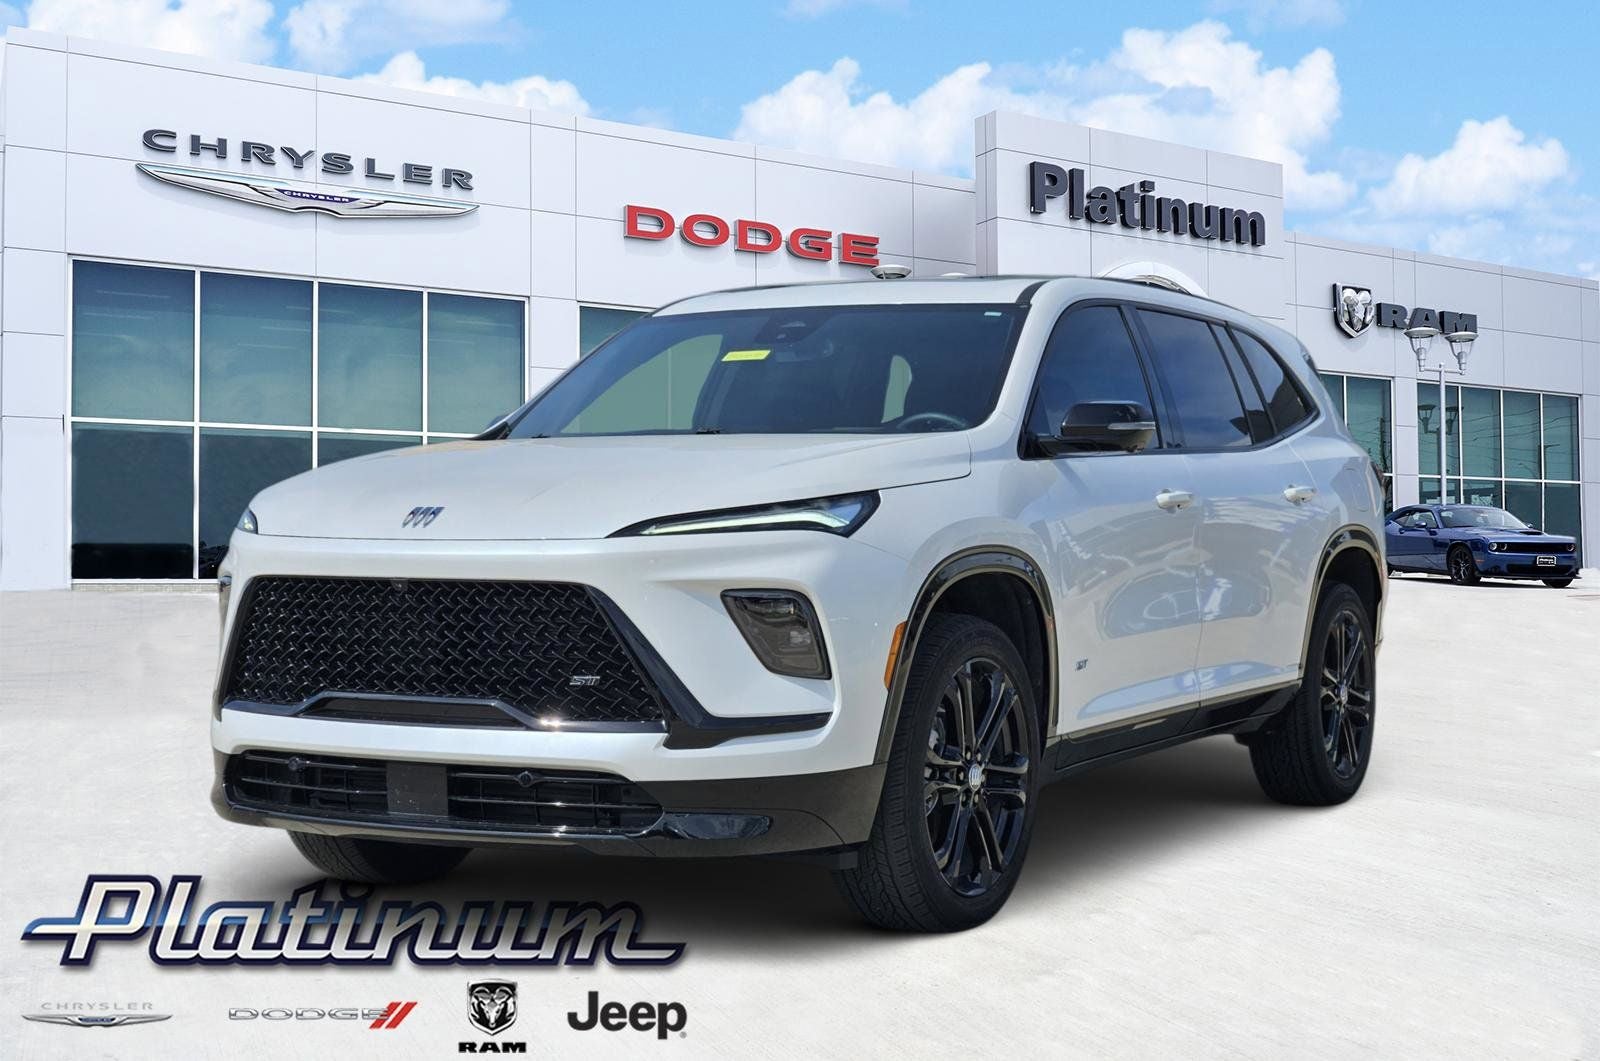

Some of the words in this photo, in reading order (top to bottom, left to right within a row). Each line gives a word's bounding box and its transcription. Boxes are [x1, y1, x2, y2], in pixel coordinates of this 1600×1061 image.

[142, 128, 474, 190] CHRYSLER
[283, 190, 350, 202] CHRYSLER
[1029, 161, 1266, 247] Platinum
[624, 204, 880, 267] DODGE
[1376, 302, 1478, 334] RAM
